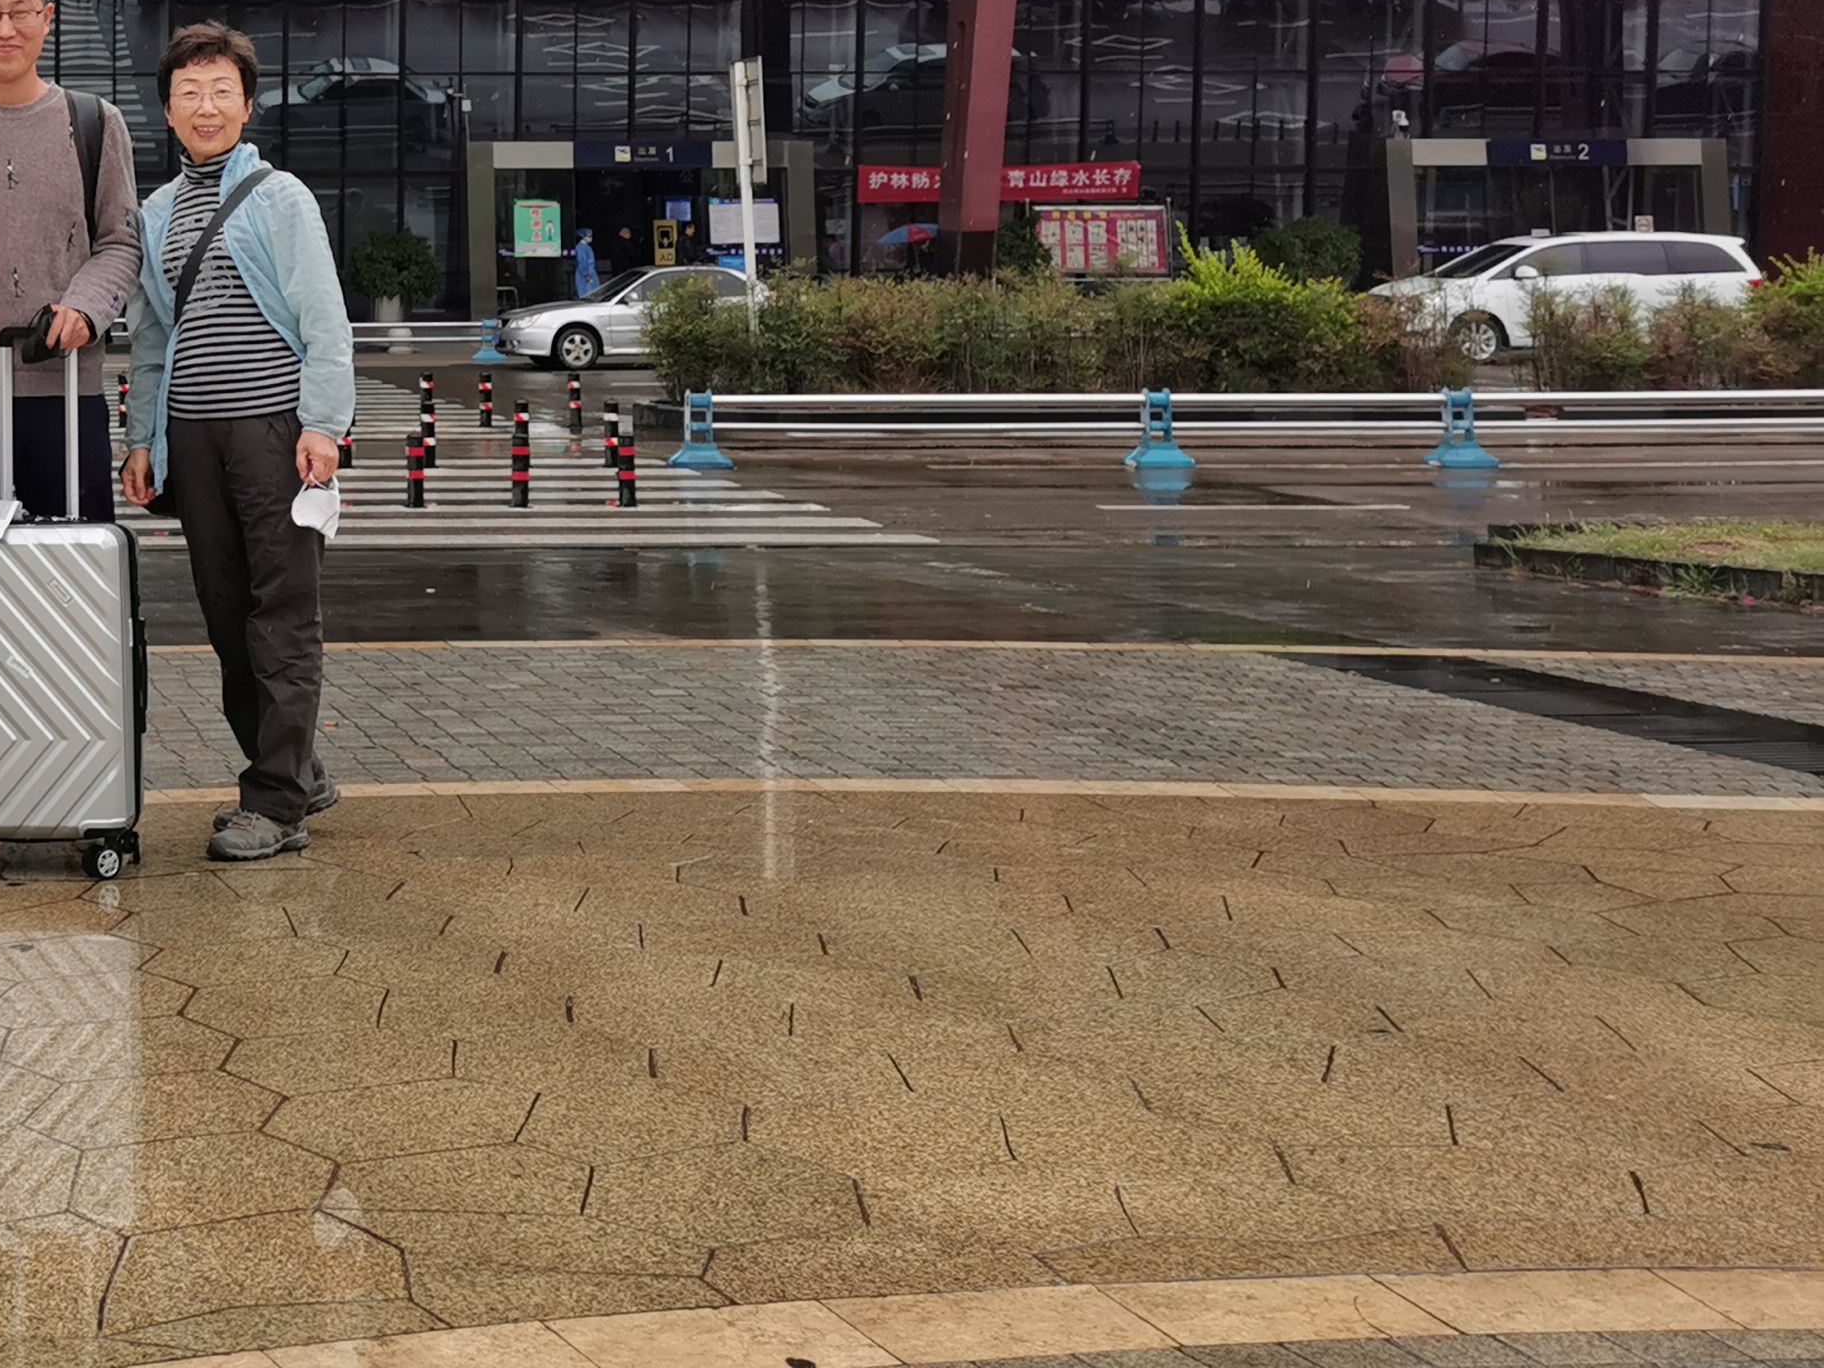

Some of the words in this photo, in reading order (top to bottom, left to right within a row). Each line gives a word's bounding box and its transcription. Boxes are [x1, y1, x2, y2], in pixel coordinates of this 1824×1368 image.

[665, 146, 674, 163] 1
[1578, 143, 1590, 160] 2
[1007, 168, 1133, 189] 青山绿水长存
